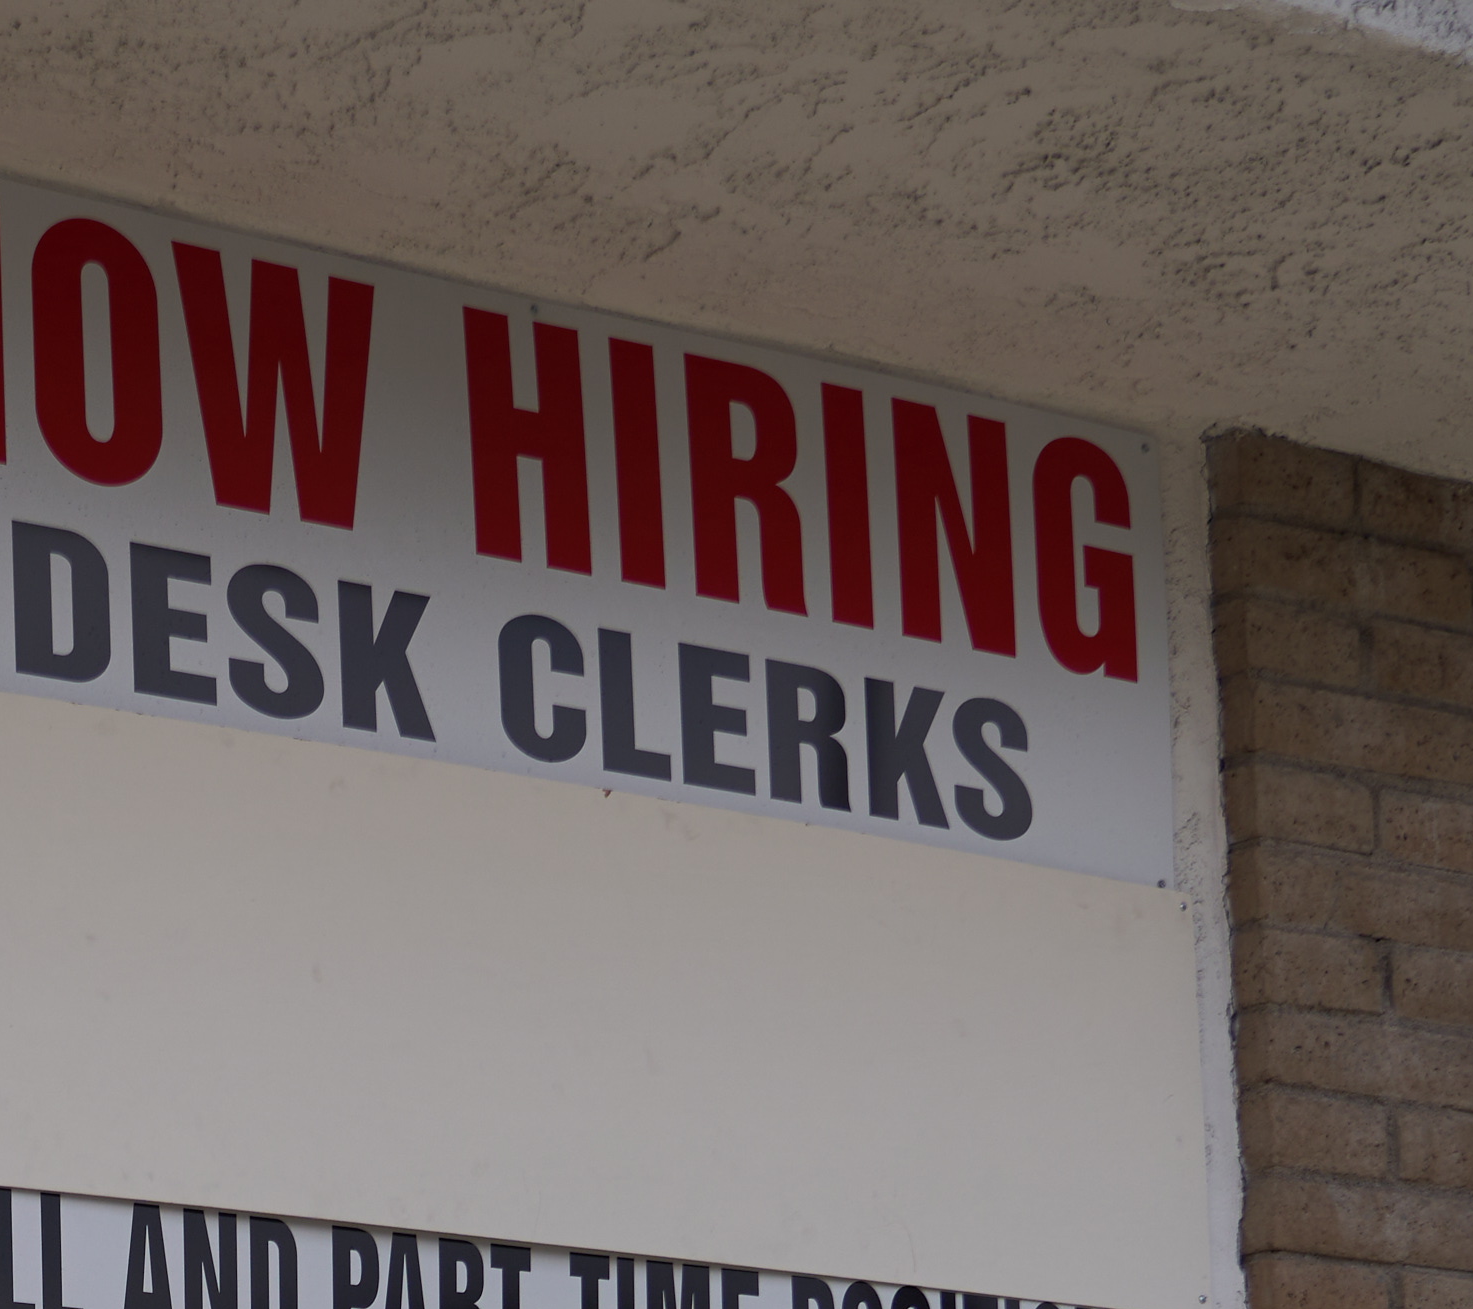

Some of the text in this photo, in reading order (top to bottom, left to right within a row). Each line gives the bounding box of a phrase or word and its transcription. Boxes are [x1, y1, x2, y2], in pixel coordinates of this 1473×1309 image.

[461, 305, 1139, 683] HIRING
[11, 519, 1033, 842] DESK CLERKS
